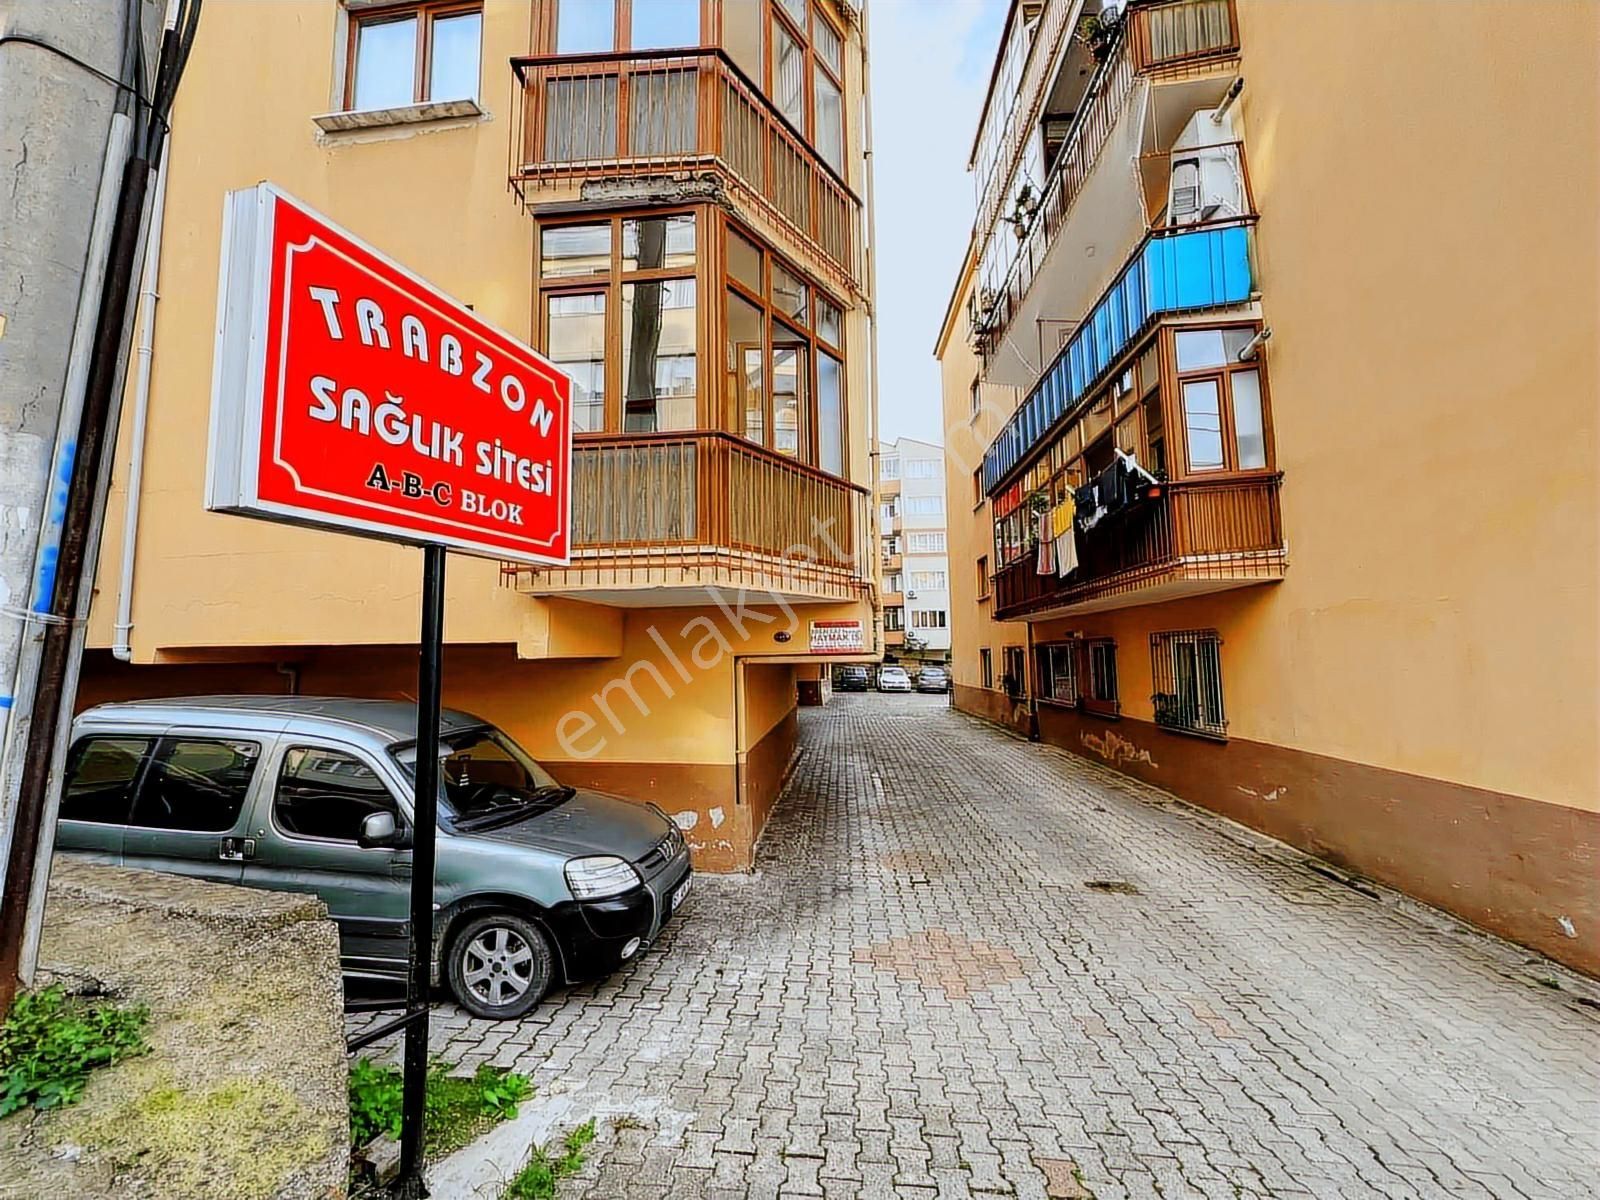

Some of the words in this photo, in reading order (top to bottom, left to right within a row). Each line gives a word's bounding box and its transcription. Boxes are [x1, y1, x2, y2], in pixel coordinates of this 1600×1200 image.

[308, 285, 554, 437] TRABZON
[308, 375, 464, 467] SAĞLIK
[476, 438, 552, 497] SİTESİ
[366, 462, 452, 507] A-B-C
[460, 488, 524, 526] BLOK
